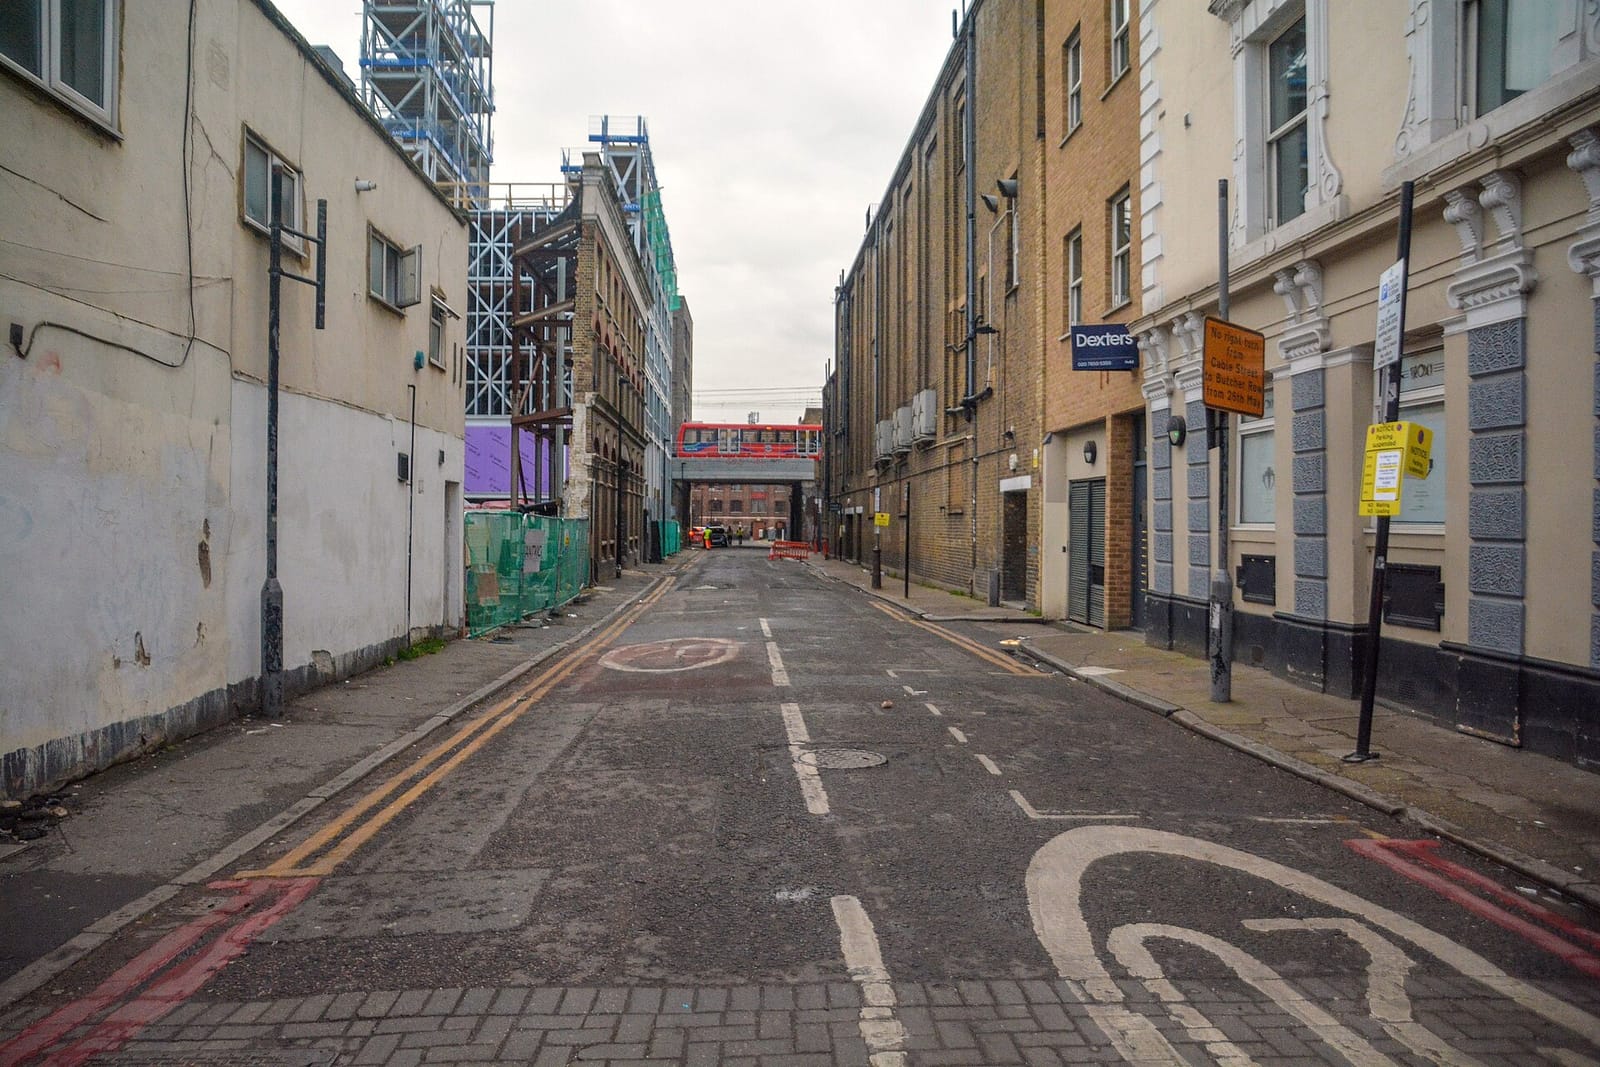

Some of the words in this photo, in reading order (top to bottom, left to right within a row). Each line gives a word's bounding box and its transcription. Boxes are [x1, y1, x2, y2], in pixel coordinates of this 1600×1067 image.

[1076, 332, 1133, 347] Dexters
[1211, 327, 1221, 339] No
[1224, 332, 1242, 345] right
[1245, 339, 1259, 351] turn
[1227, 347, 1244, 359] from
[1211, 357, 1233, 371] Cable
[1235, 363, 1258, 378] Street
[1205, 372, 1212, 381] to
[1216, 373, 1246, 389] Butcher
[1206, 385, 1225, 399] from
[1376, 424, 1395, 433] NOTICE
[1411, 446, 1427, 459] NOTICE
